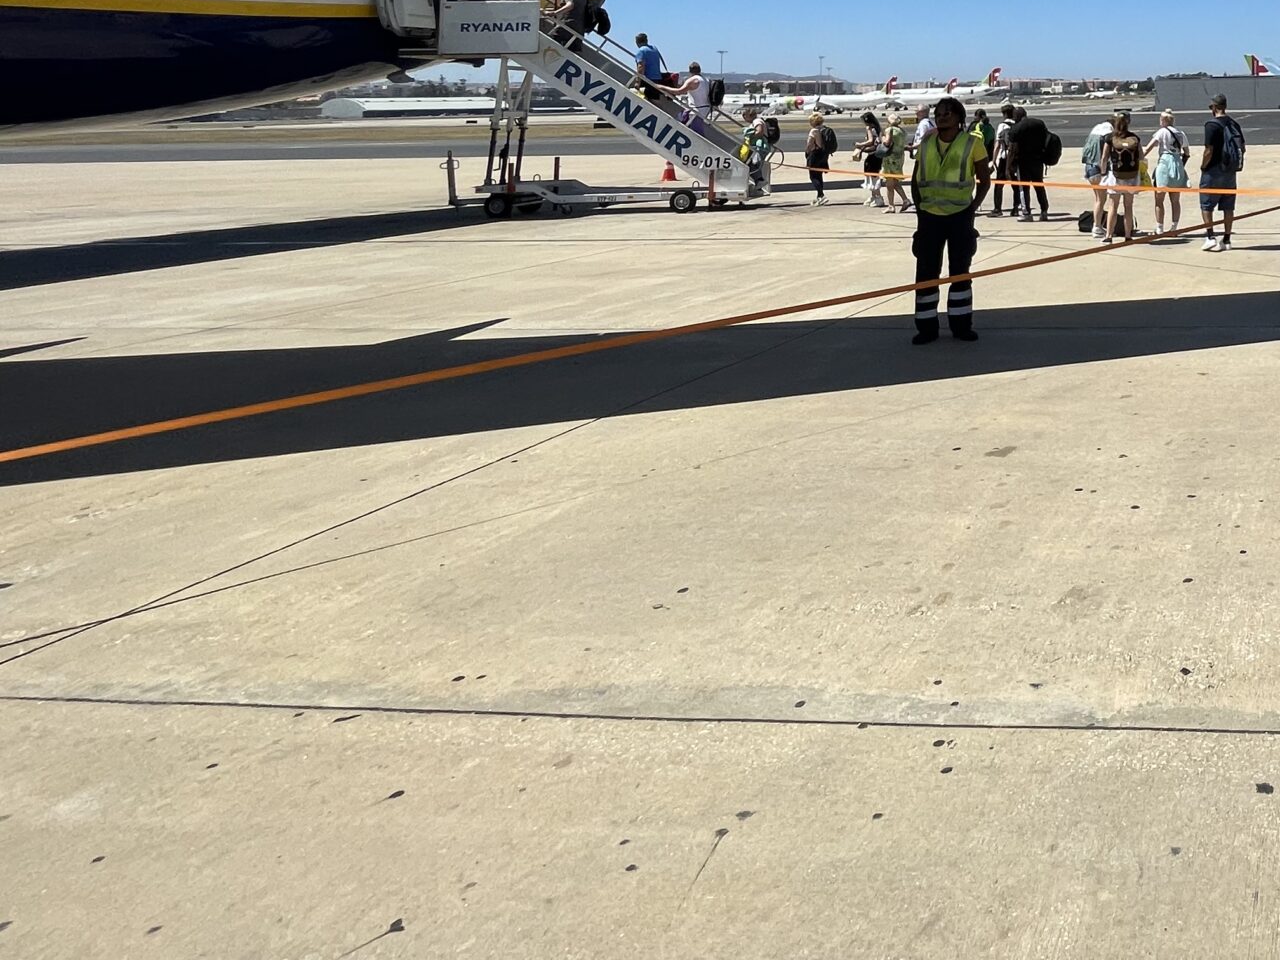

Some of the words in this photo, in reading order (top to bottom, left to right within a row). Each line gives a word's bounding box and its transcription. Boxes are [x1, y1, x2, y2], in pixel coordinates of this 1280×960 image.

[460, 22, 531, 33] RYANAIR
[554, 59, 692, 158] RYANAIR
[682, 155, 732, 169] 96-015
